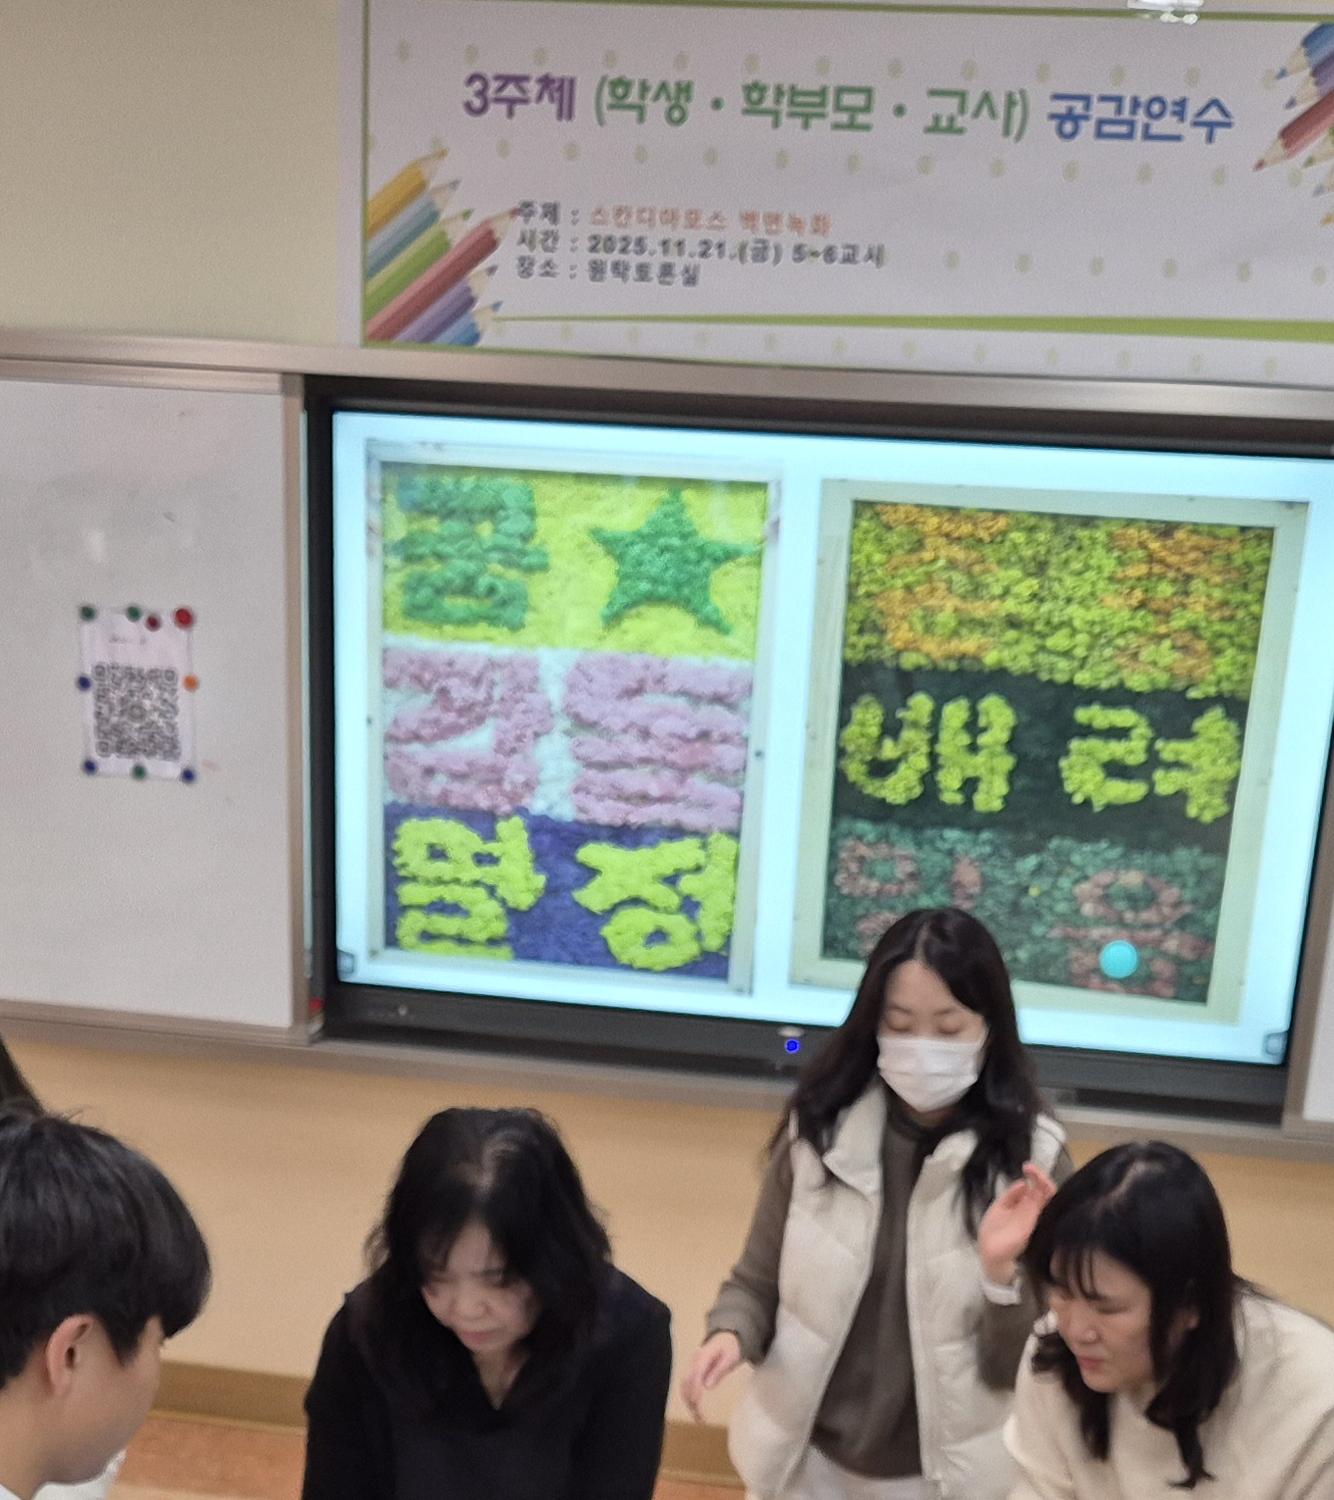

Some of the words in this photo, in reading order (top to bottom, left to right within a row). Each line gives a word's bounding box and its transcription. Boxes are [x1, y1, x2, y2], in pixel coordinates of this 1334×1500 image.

[463, 72, 576, 121] 3주체
[594, 74, 695, 127] (학생
[741, 80, 874, 131] 학부모
[923, 88, 1030, 143] 교사)
[1048, 93, 1233, 144] 공감연수
[518, 200, 560, 226] 주제
[516, 229, 560, 253] 시간
[516, 255, 559, 280] 장소
[840, 691, 1243, 823] 배려
[391, 813, 739, 972] 열정
